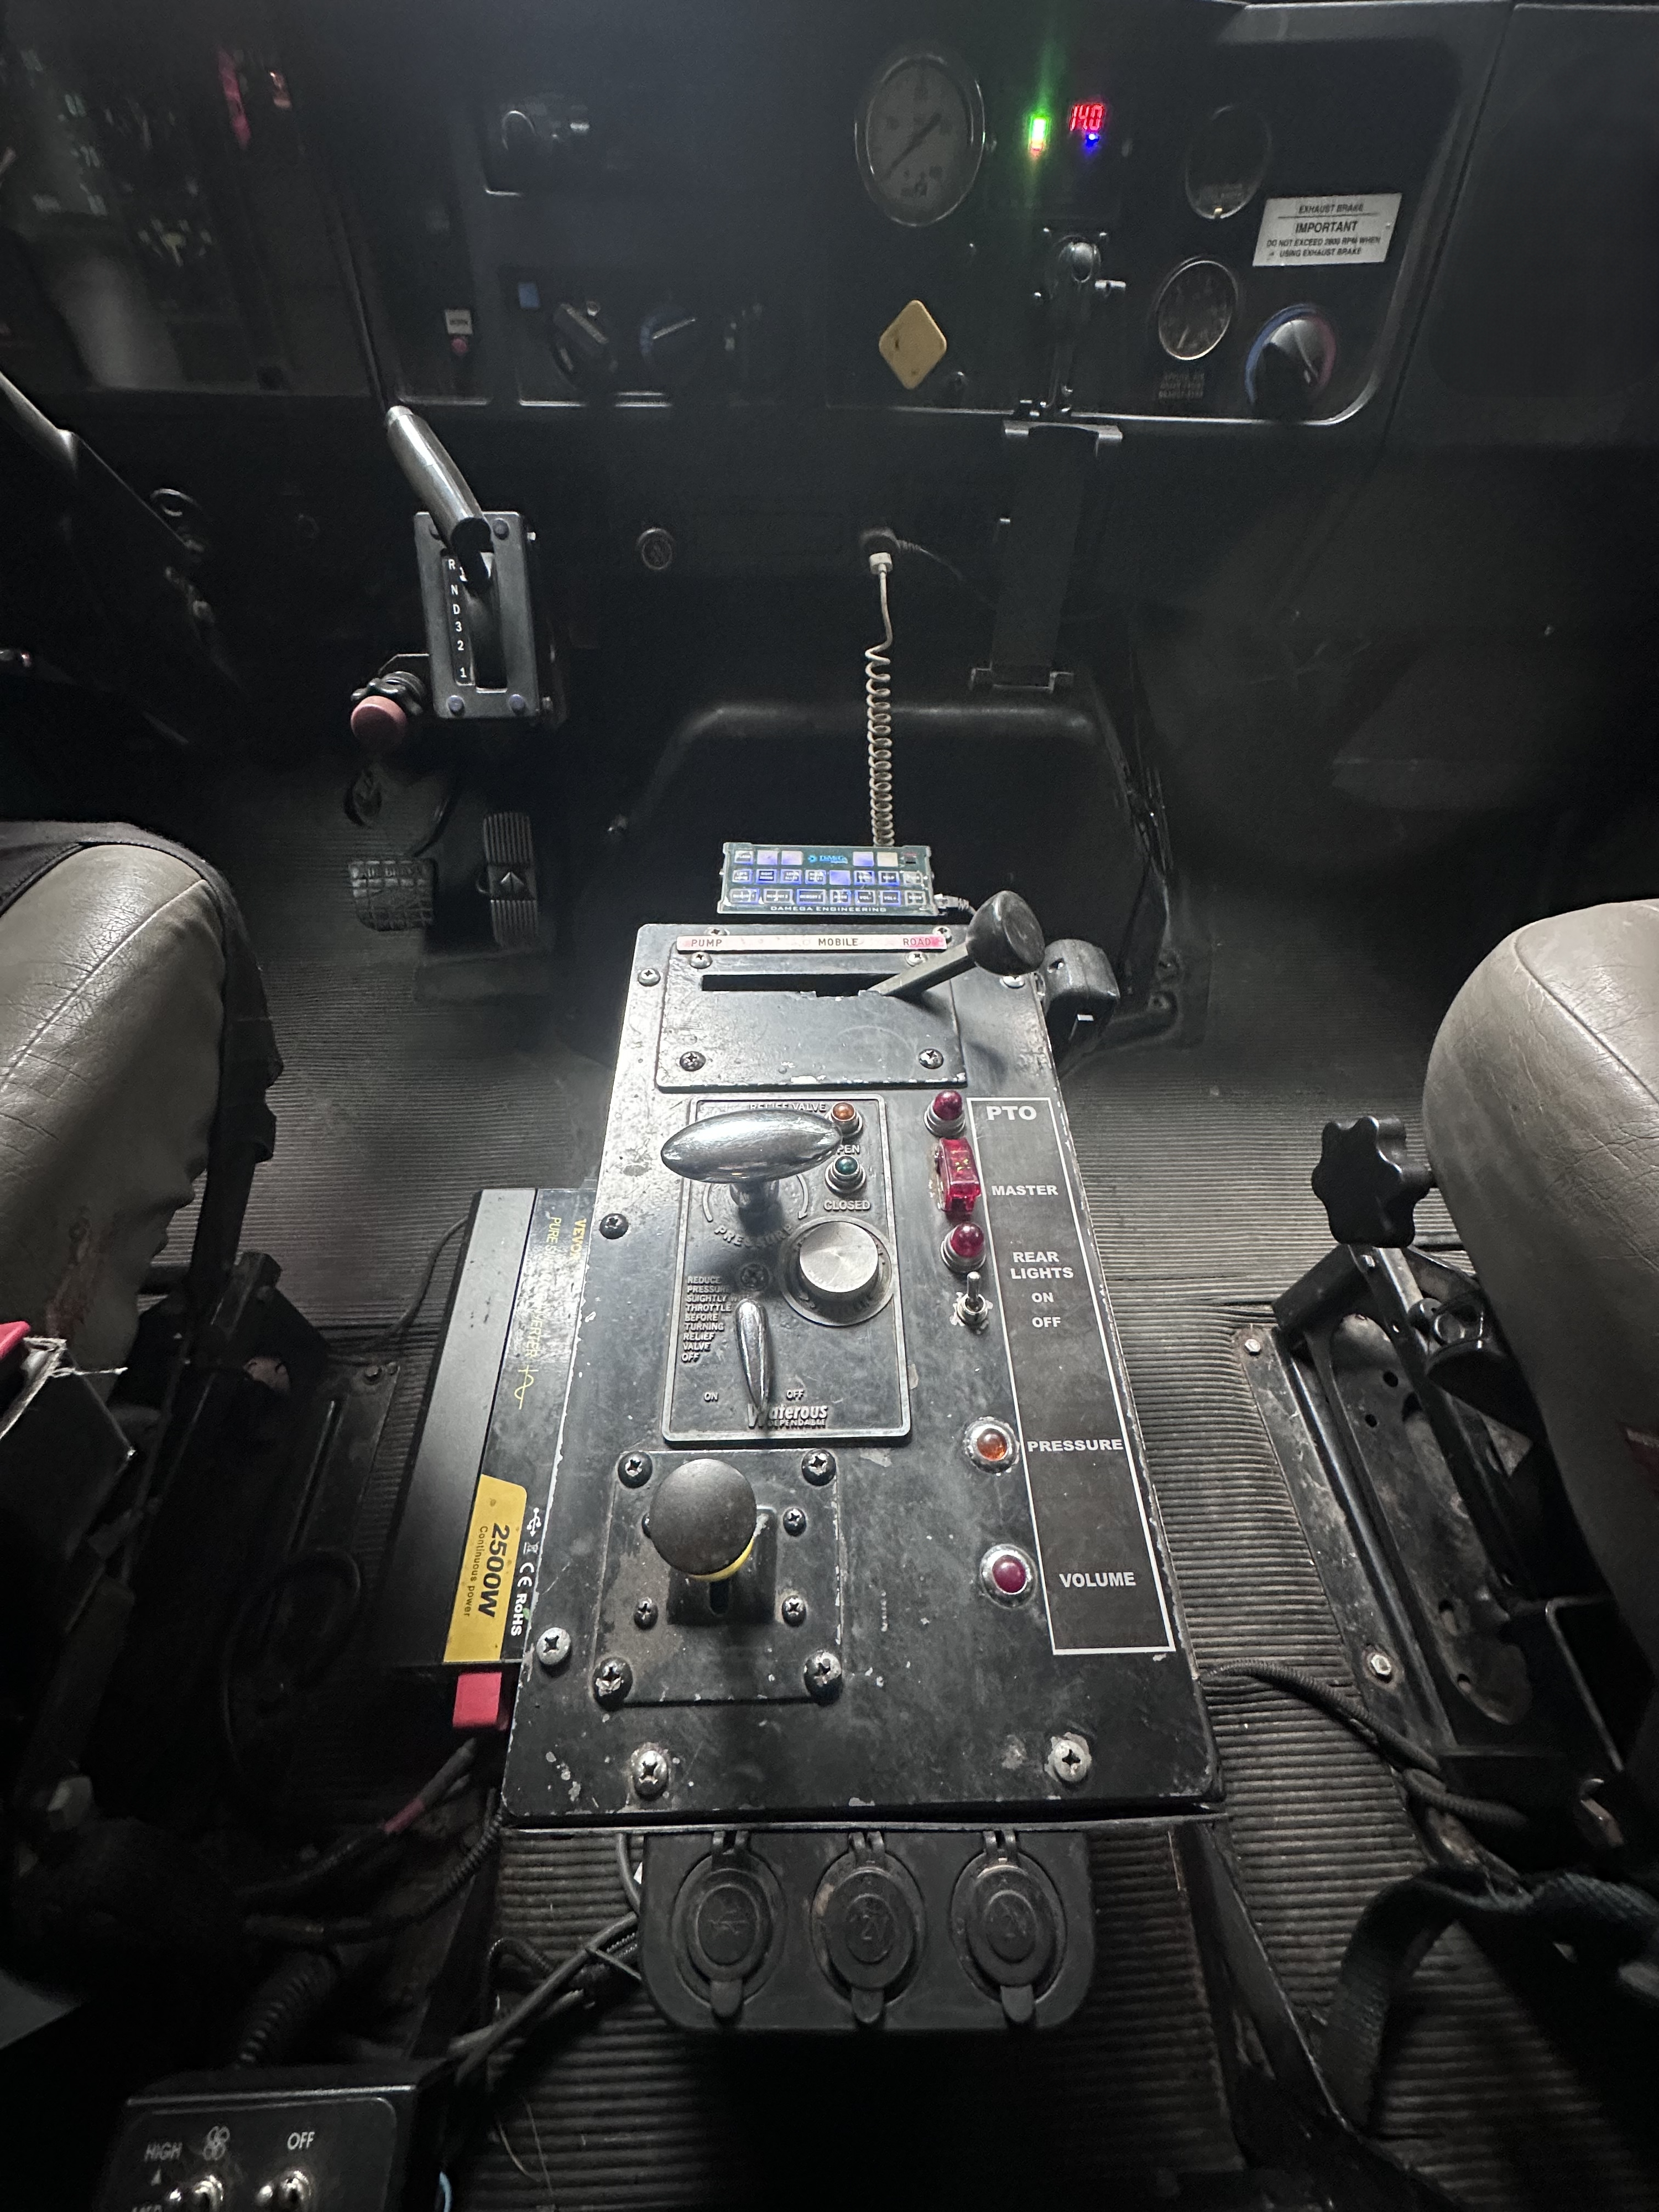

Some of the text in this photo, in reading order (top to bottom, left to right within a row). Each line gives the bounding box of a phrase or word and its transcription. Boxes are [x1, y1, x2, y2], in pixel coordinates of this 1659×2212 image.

[1070, 104, 1104, 131] 140
[1300, 204, 1364, 213] EXHAUST BRAKE
[1295, 221, 1358, 233] IMPORTANT
[448, 559, 456, 570] R
[451, 584, 458, 595] N
[453, 604, 460, 614] D
[455, 621, 462, 632] 3
[457, 640, 464, 651] 2
[460, 667, 467, 678] 1
[691, 938, 722, 947] PUMP
[818, 937, 859, 946] MOBILE
[902, 938, 932, 946] ROAD
[792, 1102, 826, 1112] VALVE
[987, 1105, 1037, 1120] PTO
[837, 1144, 860, 1154] PEN
[992, 1185, 1058, 1196] MASTER
[823, 1199, 872, 1211] CLOSED
[546, 1217, 562, 1244] PURE
[1013, 1251, 1060, 1263] REAR
[1010, 1266, 1074, 1279] LIGHTS
[687, 1276, 722, 1284] REDUCE
[1031, 1292, 1054, 1303] ON
[686, 1303, 732, 1312] THROTTLE
[685, 1313, 718, 1322] BEFORE
[1032, 1317, 1061, 1328] OFF
[685, 1322, 724, 1331] TURNING
[683, 1332, 715, 1340] RELIEF
[683, 1342, 711, 1350] VALVE
[681, 1353, 700, 1361] OFF
[704, 1392, 718, 1401] ON
[786, 1389, 805, 1399] OFF
[1027, 1439, 1124, 1452] PRESSURE
[463, 1525, 488, 1618] Continuous power
[478, 1522, 510, 1618] 2500W
[1060, 1572, 1137, 1588] VOLUME
[510, 1593, 528, 1637] RoHS
[286, 2131, 315, 2151] OFF
[144, 2141, 183, 2162] HIGH
